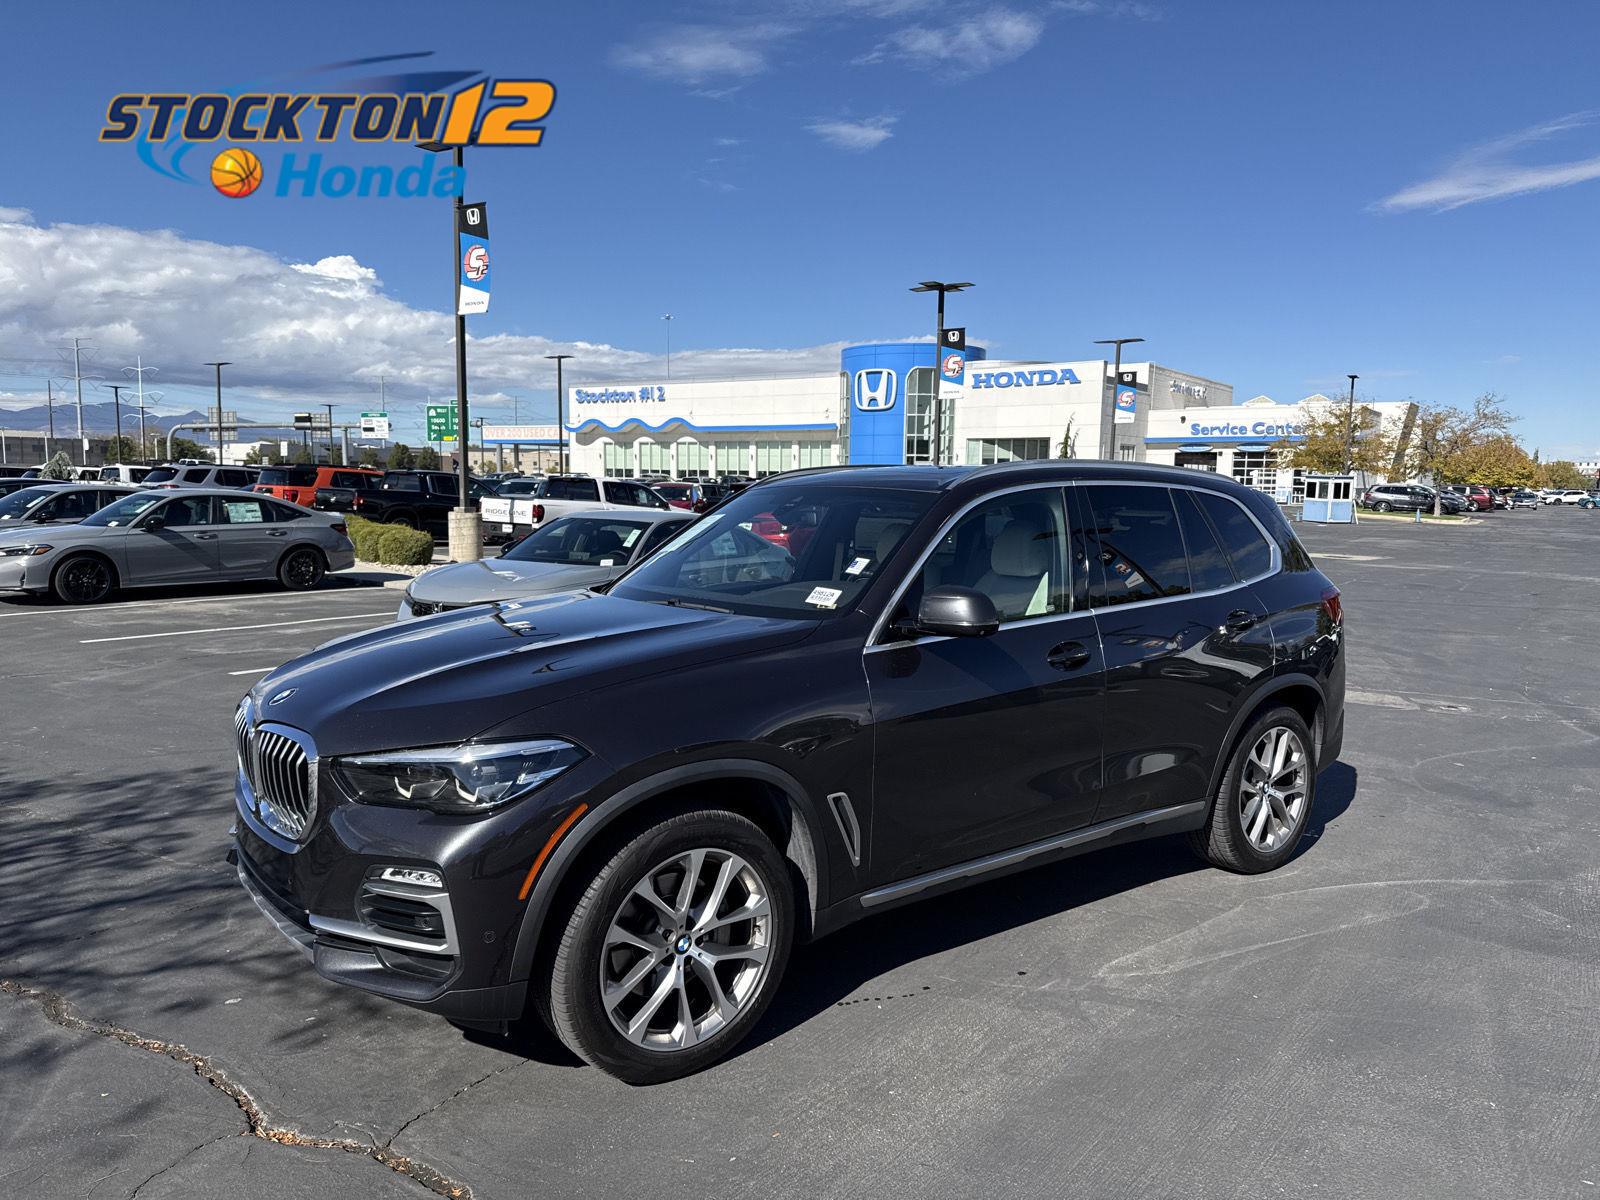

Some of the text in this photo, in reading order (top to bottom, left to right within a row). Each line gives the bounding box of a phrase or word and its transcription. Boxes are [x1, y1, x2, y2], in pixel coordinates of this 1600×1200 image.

[971, 363, 1082, 389] HONDA
[575, 388, 637, 404] Stockton
[1190, 423, 1248, 436] Service
